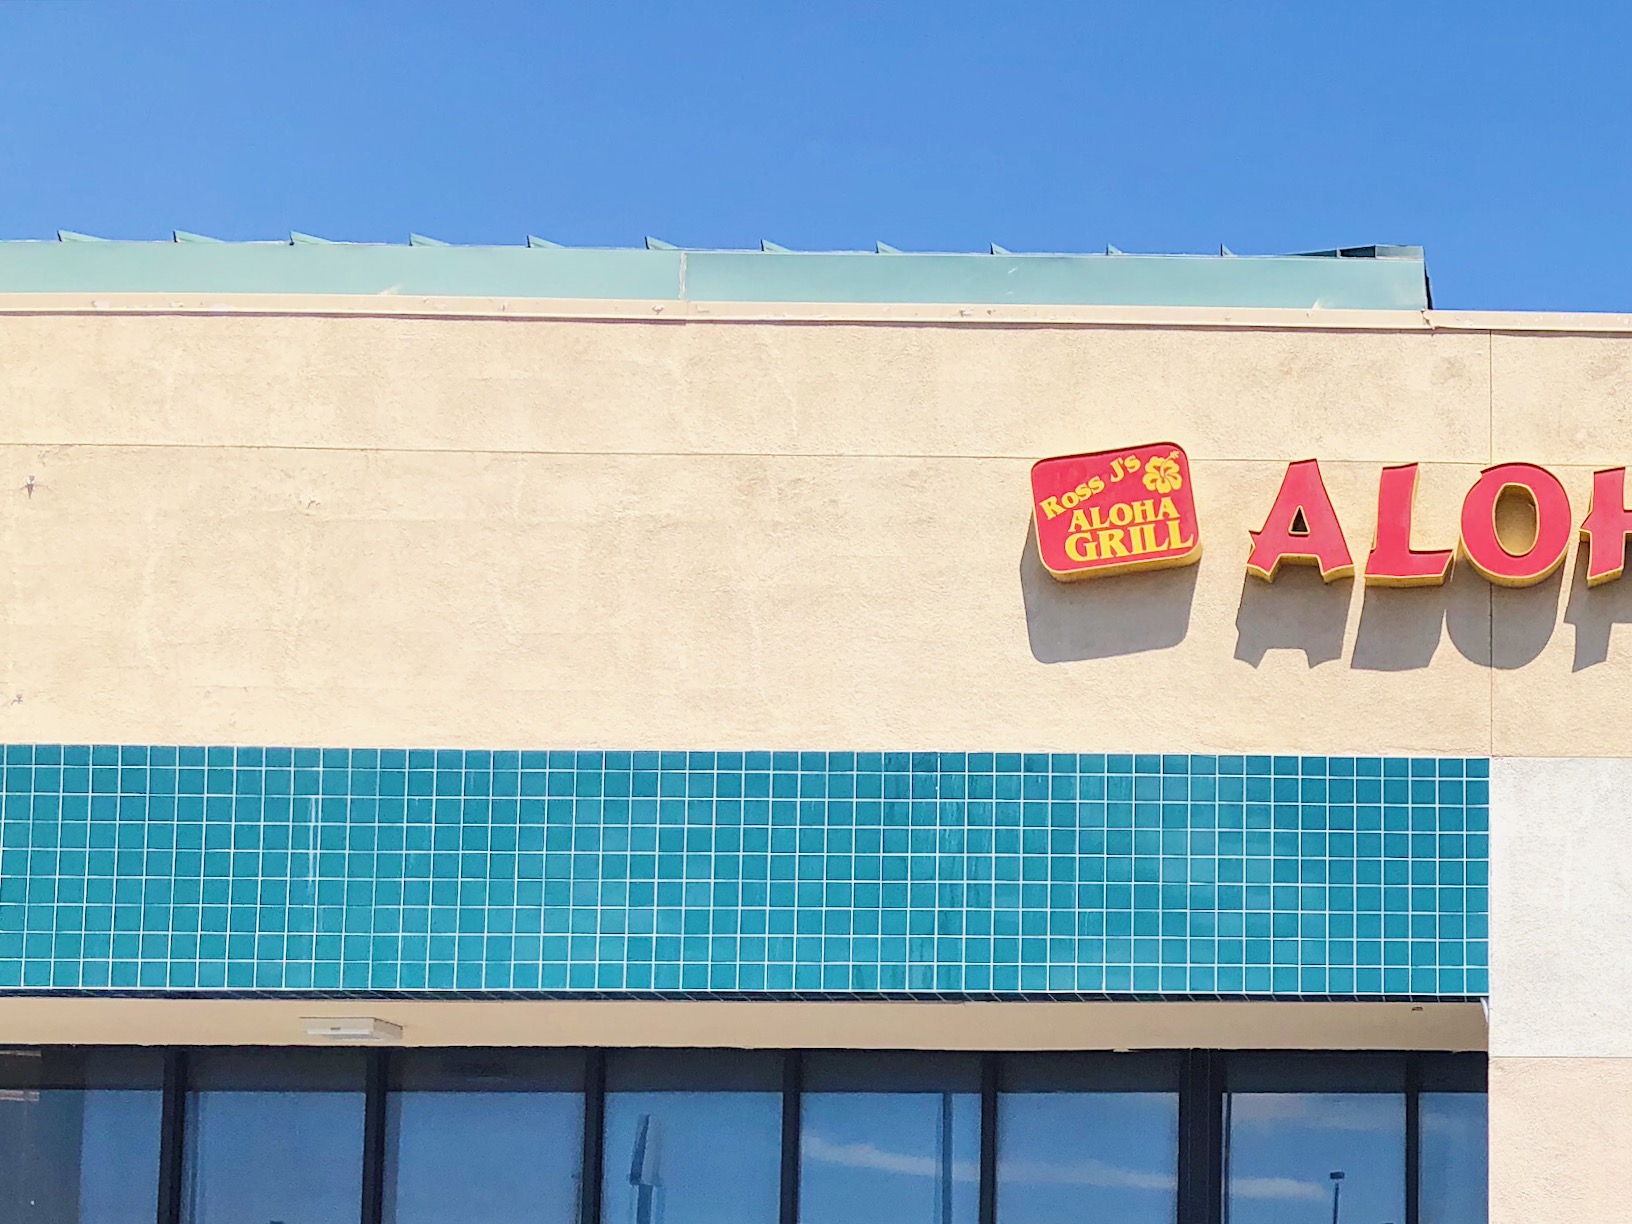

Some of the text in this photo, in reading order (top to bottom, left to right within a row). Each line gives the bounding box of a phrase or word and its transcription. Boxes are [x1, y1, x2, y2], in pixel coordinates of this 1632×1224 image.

[1039, 454, 1142, 520] Ross J's
[1067, 496, 1181, 533] ALOHA
[1064, 519, 1194, 562] GRILL
